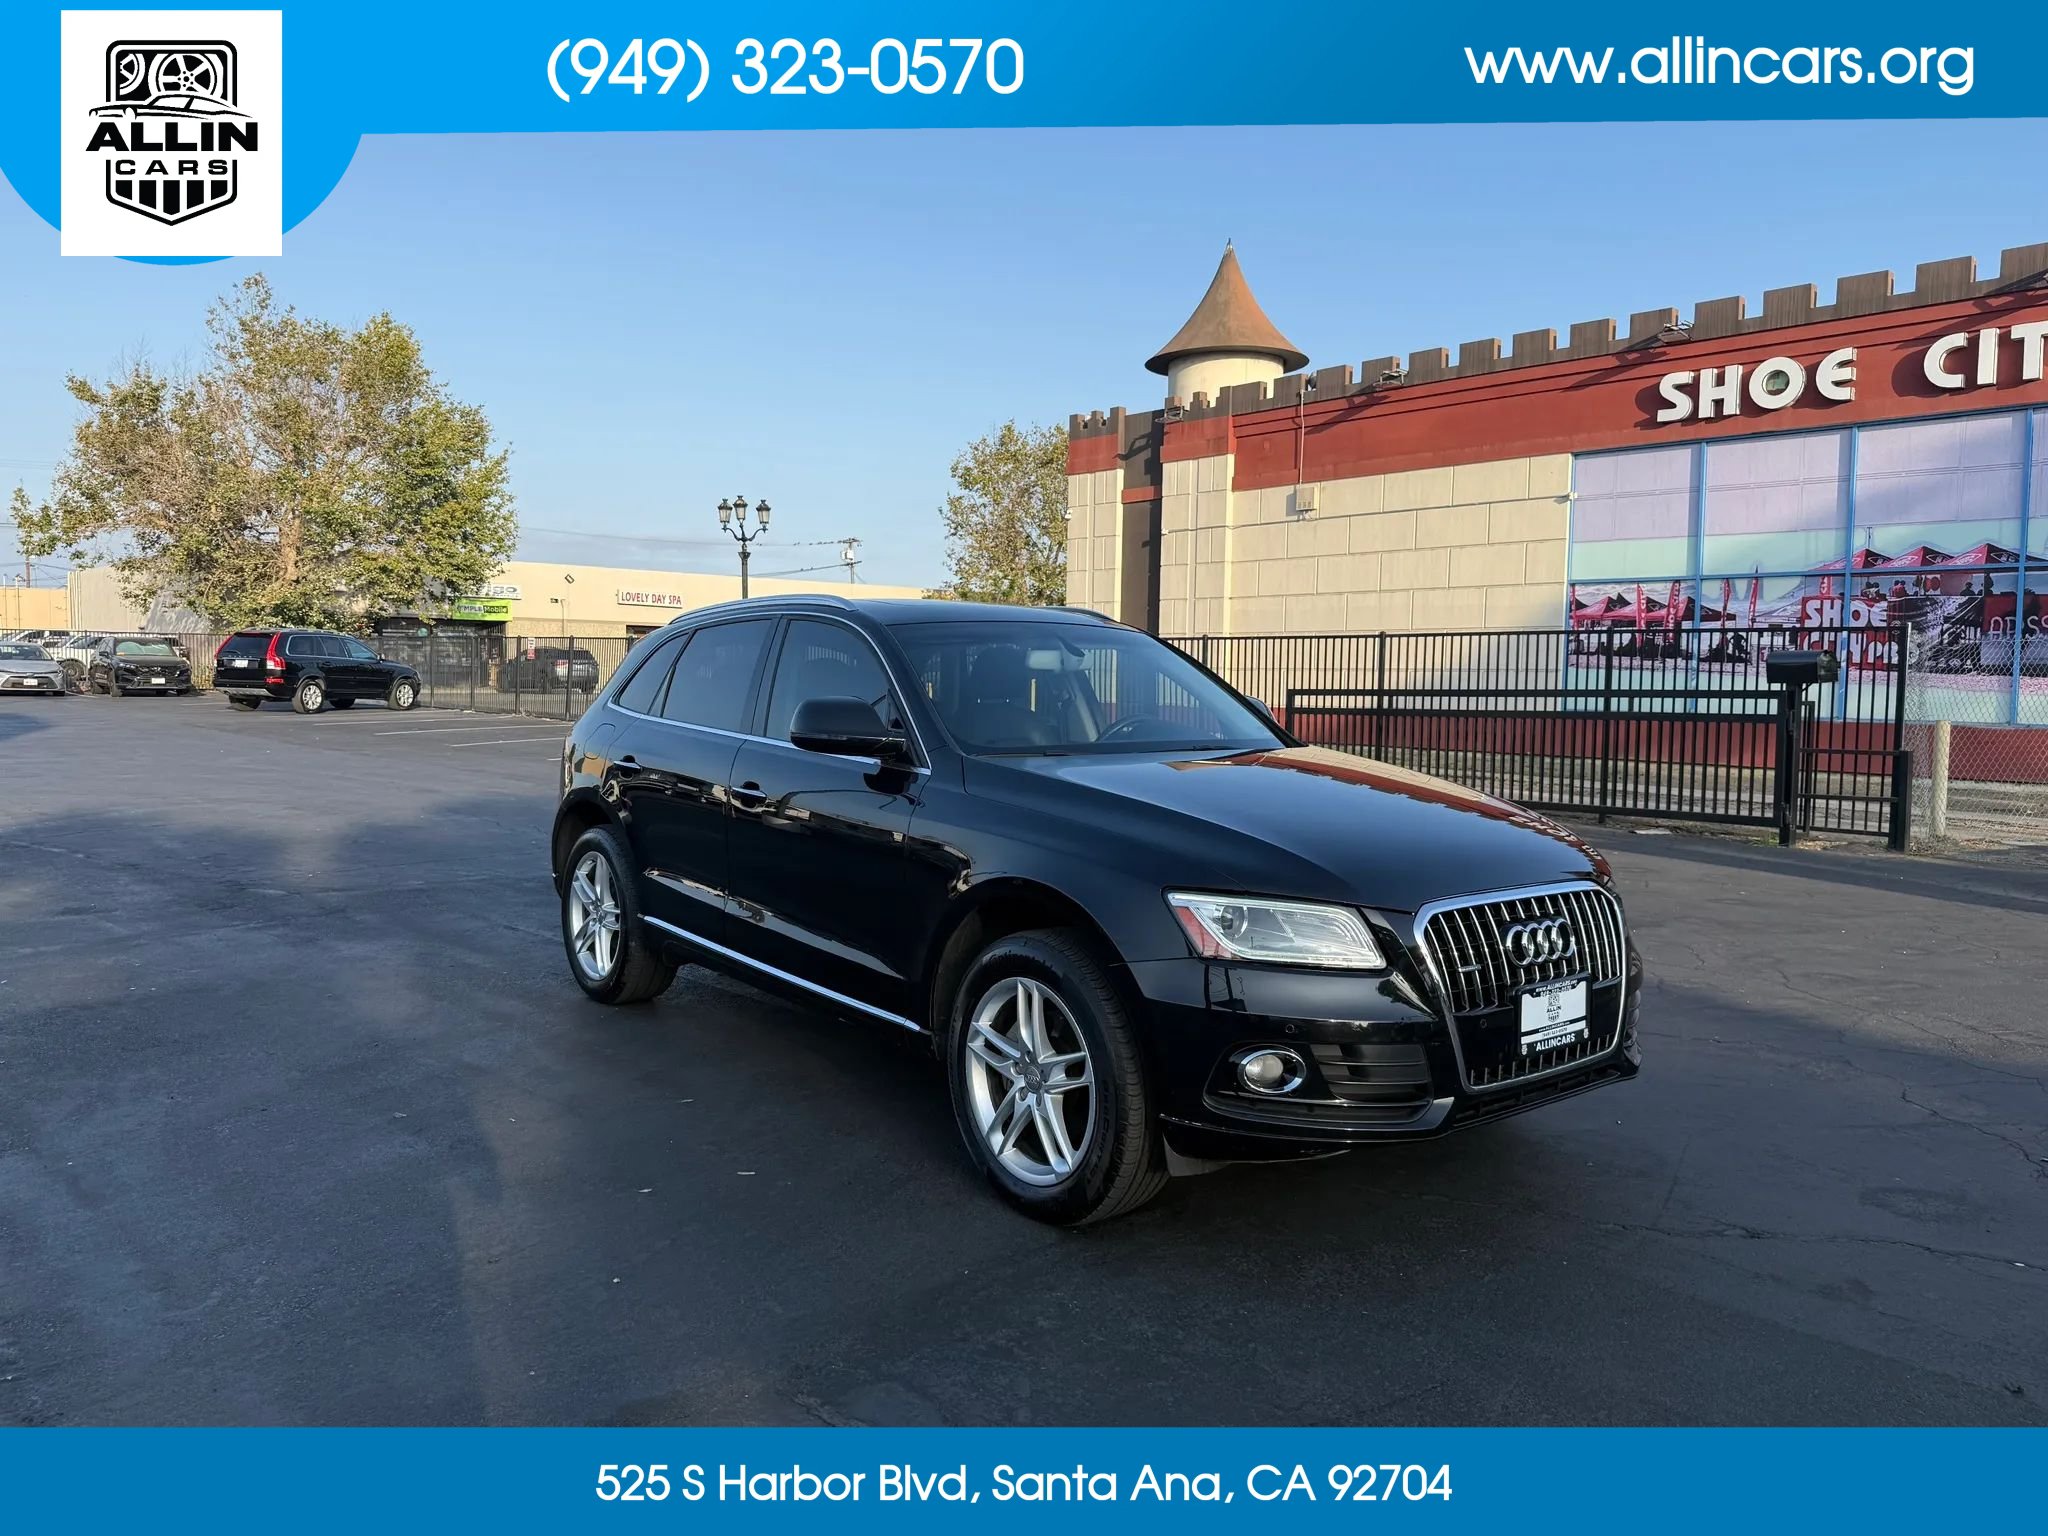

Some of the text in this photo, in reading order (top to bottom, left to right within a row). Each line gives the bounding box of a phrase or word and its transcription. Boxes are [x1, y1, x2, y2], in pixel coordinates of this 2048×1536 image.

[1656, 346, 1858, 423] SHOE
[621, 591, 682, 606] LOVELY DAY SPA
[484, 605, 508, 613] Mobile
[1804, 600, 1888, 628] SHOE
[1535, 1033, 1576, 1052] ALLINCARS
